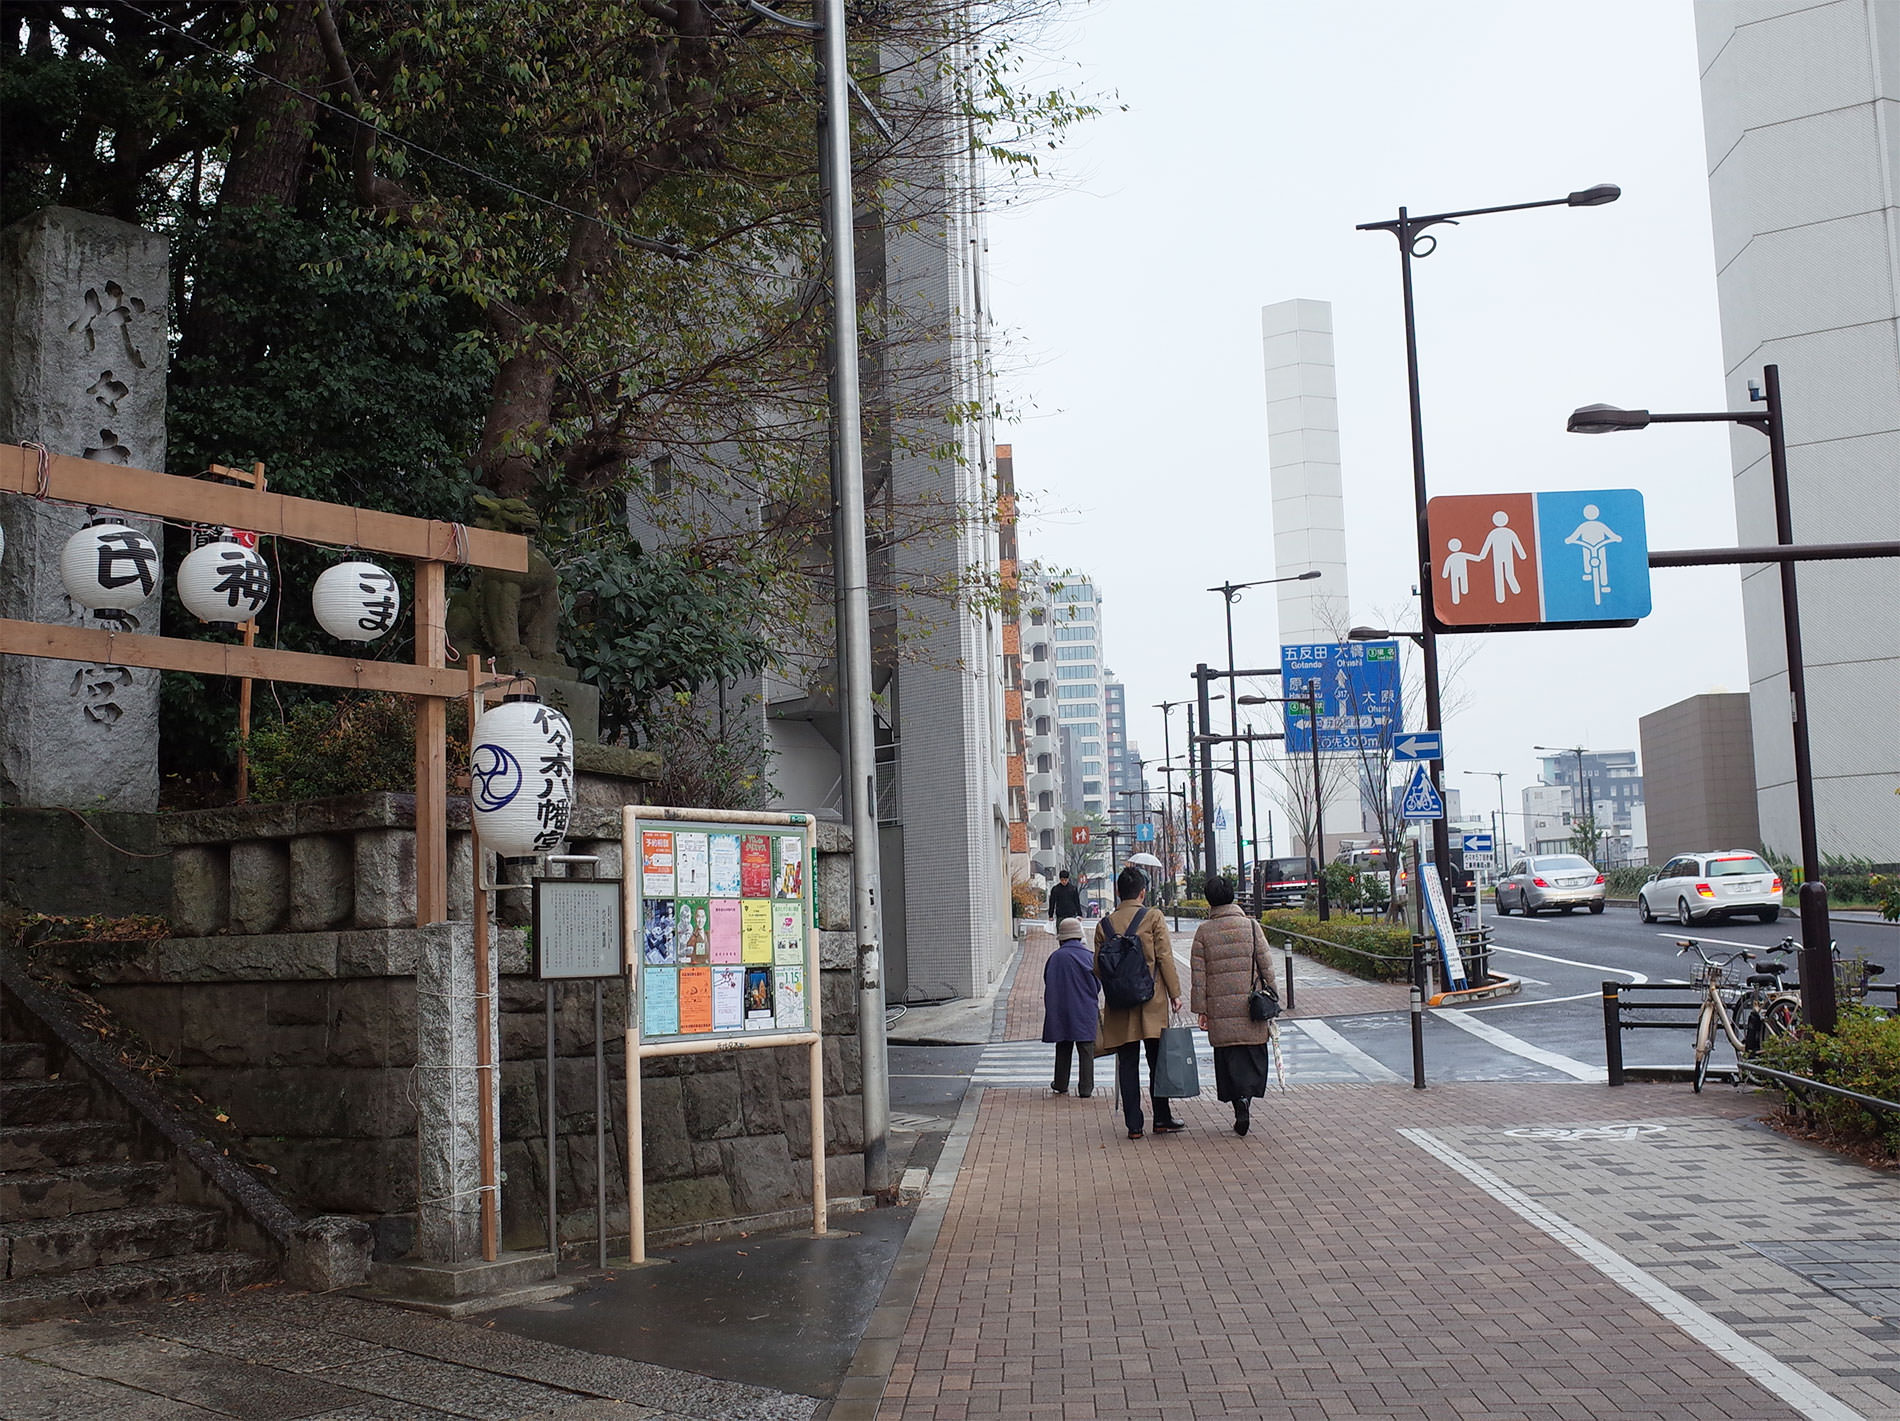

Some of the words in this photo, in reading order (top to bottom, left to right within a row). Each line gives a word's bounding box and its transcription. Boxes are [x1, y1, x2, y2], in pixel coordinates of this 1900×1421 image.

[97, 531, 157, 597] 氏
[213, 551, 270, 611] 神
[359, 569, 395, 632] こま
[1285, 646, 1327, 661] 五反田
[533, 708, 573, 852] 代々木八幡宮
